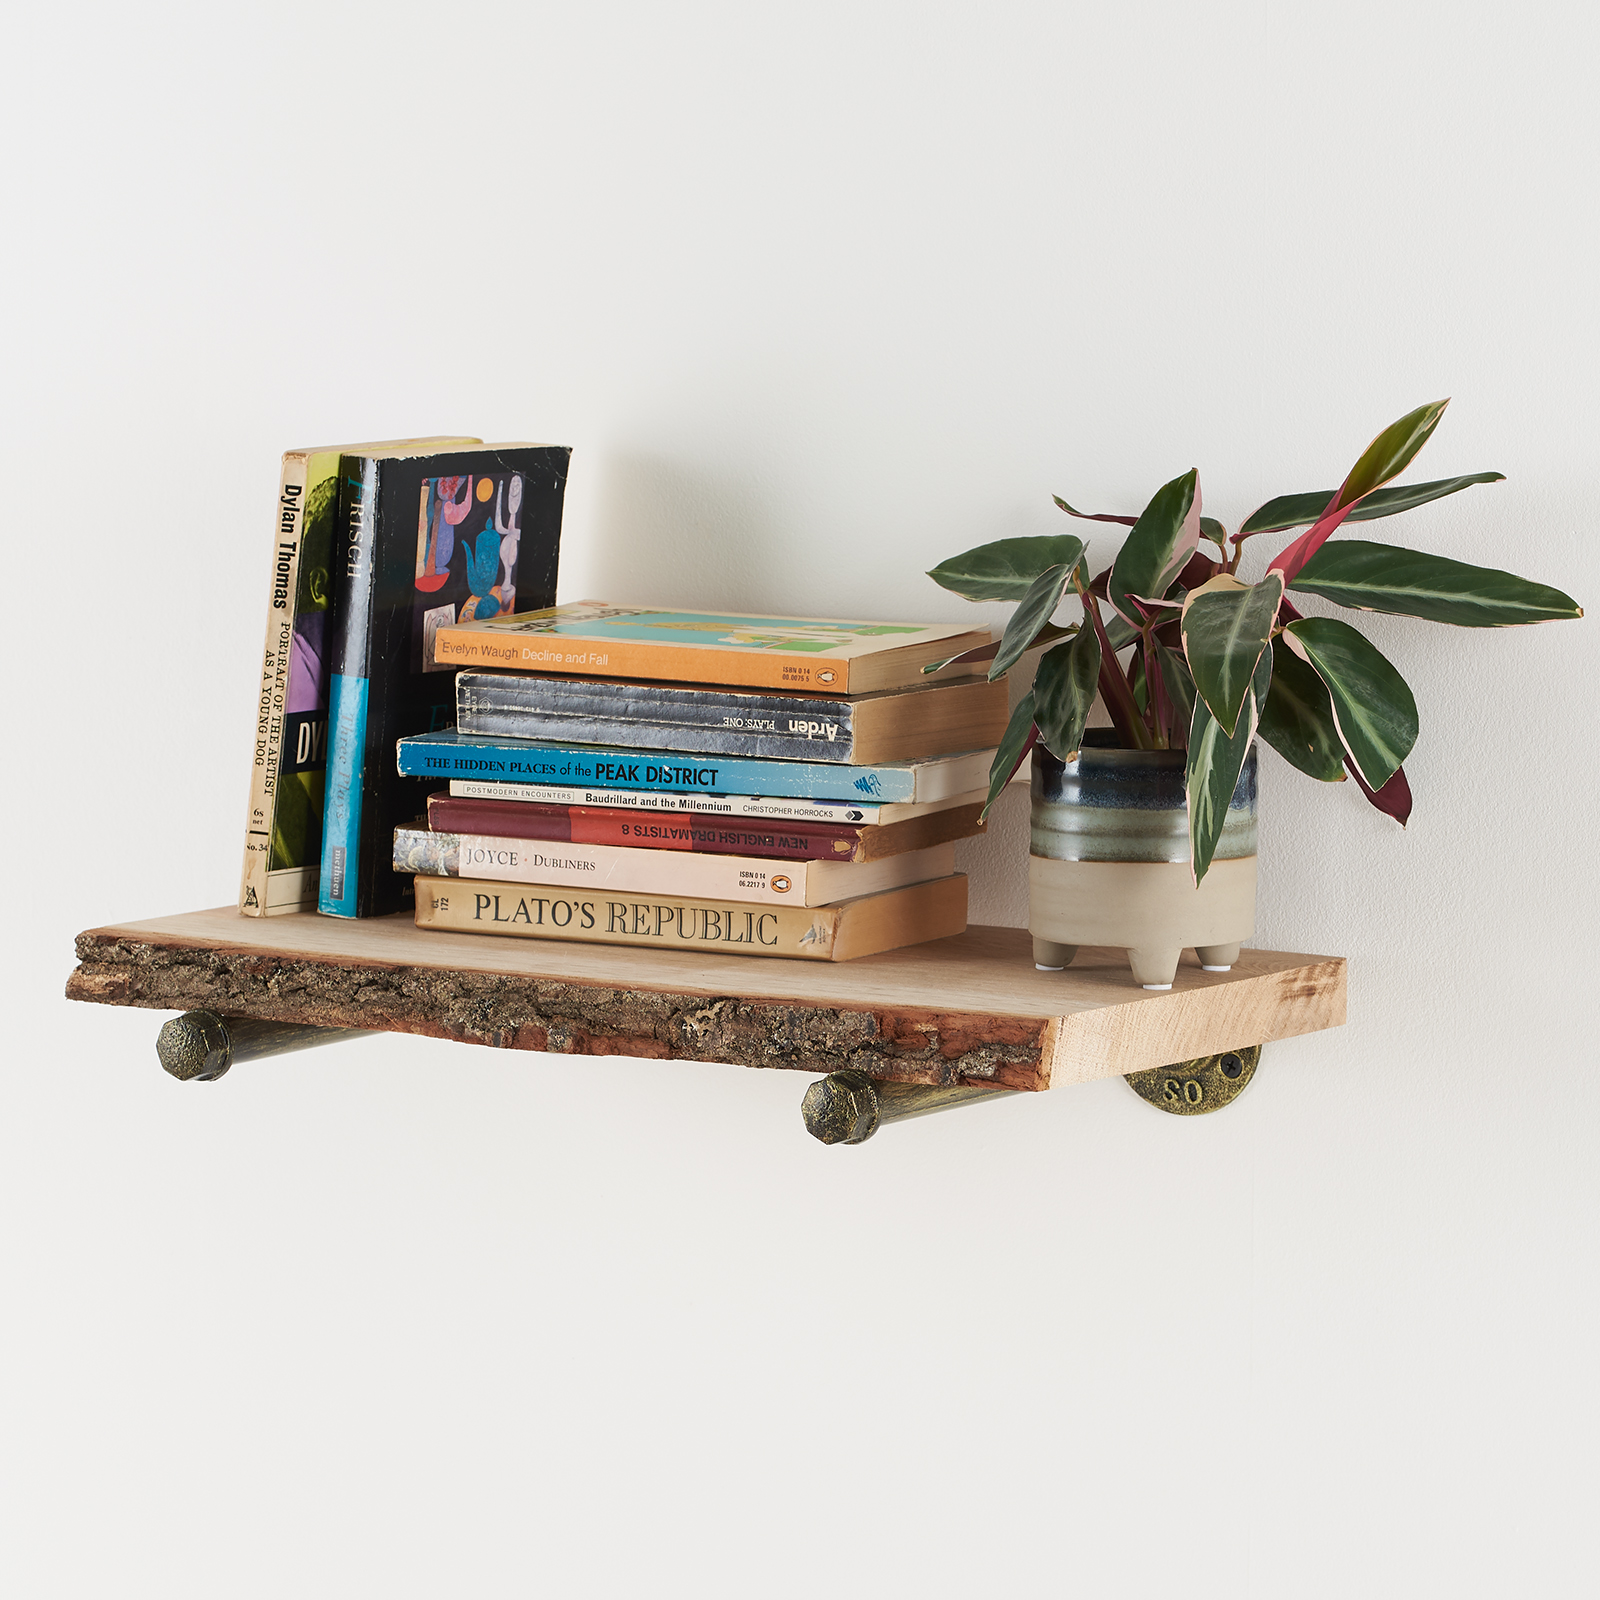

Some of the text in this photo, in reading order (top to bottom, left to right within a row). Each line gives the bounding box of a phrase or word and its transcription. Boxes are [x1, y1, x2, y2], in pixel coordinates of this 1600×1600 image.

[273, 484, 303, 609] Dylan Thomas
[442, 641, 609, 666] Evelyn Waugh Decline and Fall
[782, 666, 797, 674] ISBN
[255, 650, 275, 766] AS A YOUNG DOG
[264, 622, 291, 797] PORTRAIT OF THE ARTIST
[723, 717, 744, 728] ONE
[788, 719, 839, 742] Arden
[334, 713, 354, 820] Three Plays
[424, 756, 719, 787] THE HIDDEN PLACES of the PEAK DISTRICT
[466, 785, 833, 818] POSTMODERN ENCOUNTERS Baudrillard and the Millennium CHRISTOPHER HORROCKS
[621, 823, 808, 851] NEW ENGLISH DRAMATISTS 8
[333, 850, 343, 896] methuen
[466, 848, 596, 871] JOYCE DUBLINERS
[739, 870, 754, 878] ISBN
[440, 897, 449, 911] 172
[473, 892, 595, 929] PLATO'S
[604, 901, 778, 946] REPUBLIC
